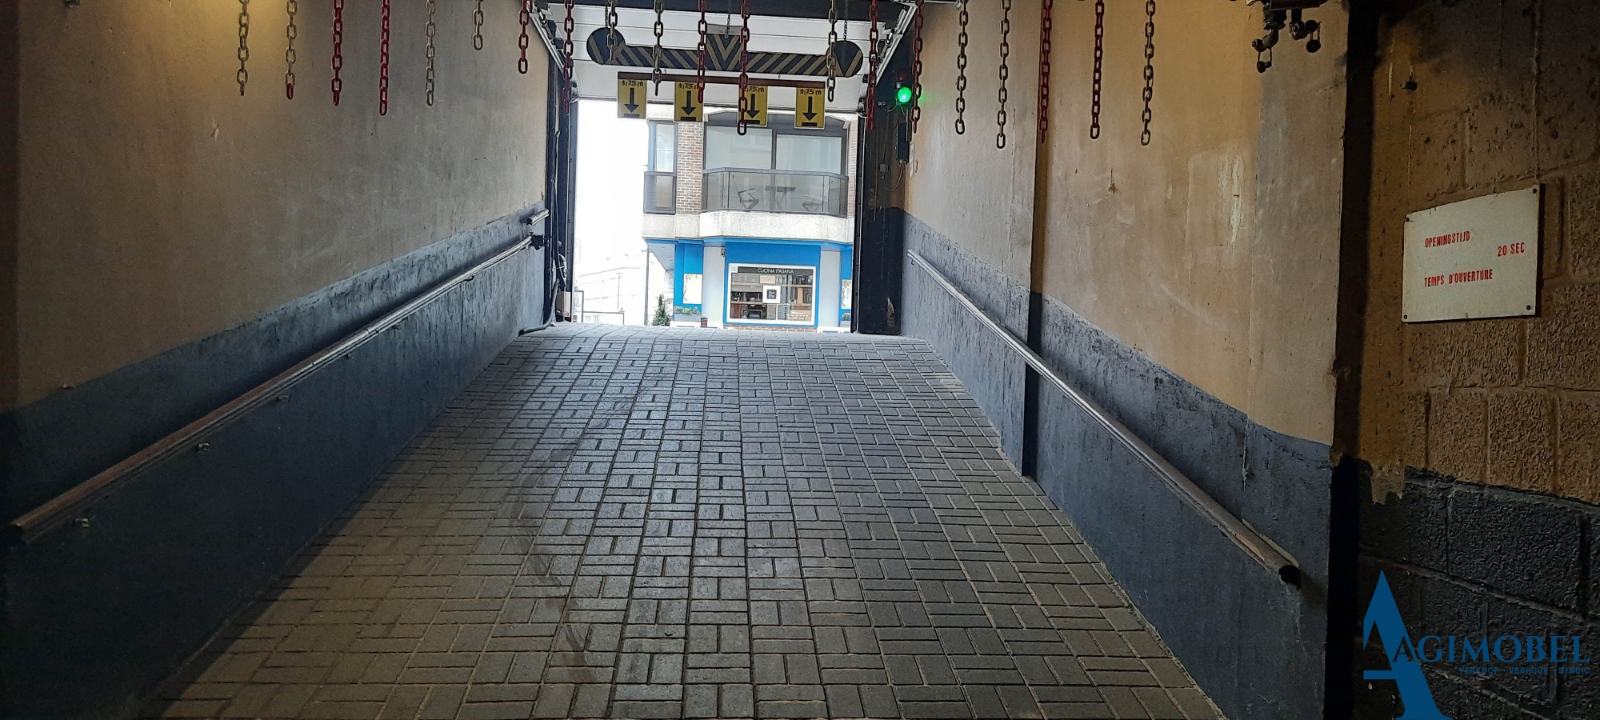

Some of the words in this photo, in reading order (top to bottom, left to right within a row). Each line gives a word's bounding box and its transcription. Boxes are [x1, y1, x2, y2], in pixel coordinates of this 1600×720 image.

[1425, 230, 1470, 248] OPENINGSTIJD
[1497, 246, 1508, 257] 20
[1510, 242, 1525, 255] SEC
[1424, 274, 1444, 287] TEMPS
[1448, 269, 1493, 284] D'OUVERTURE
